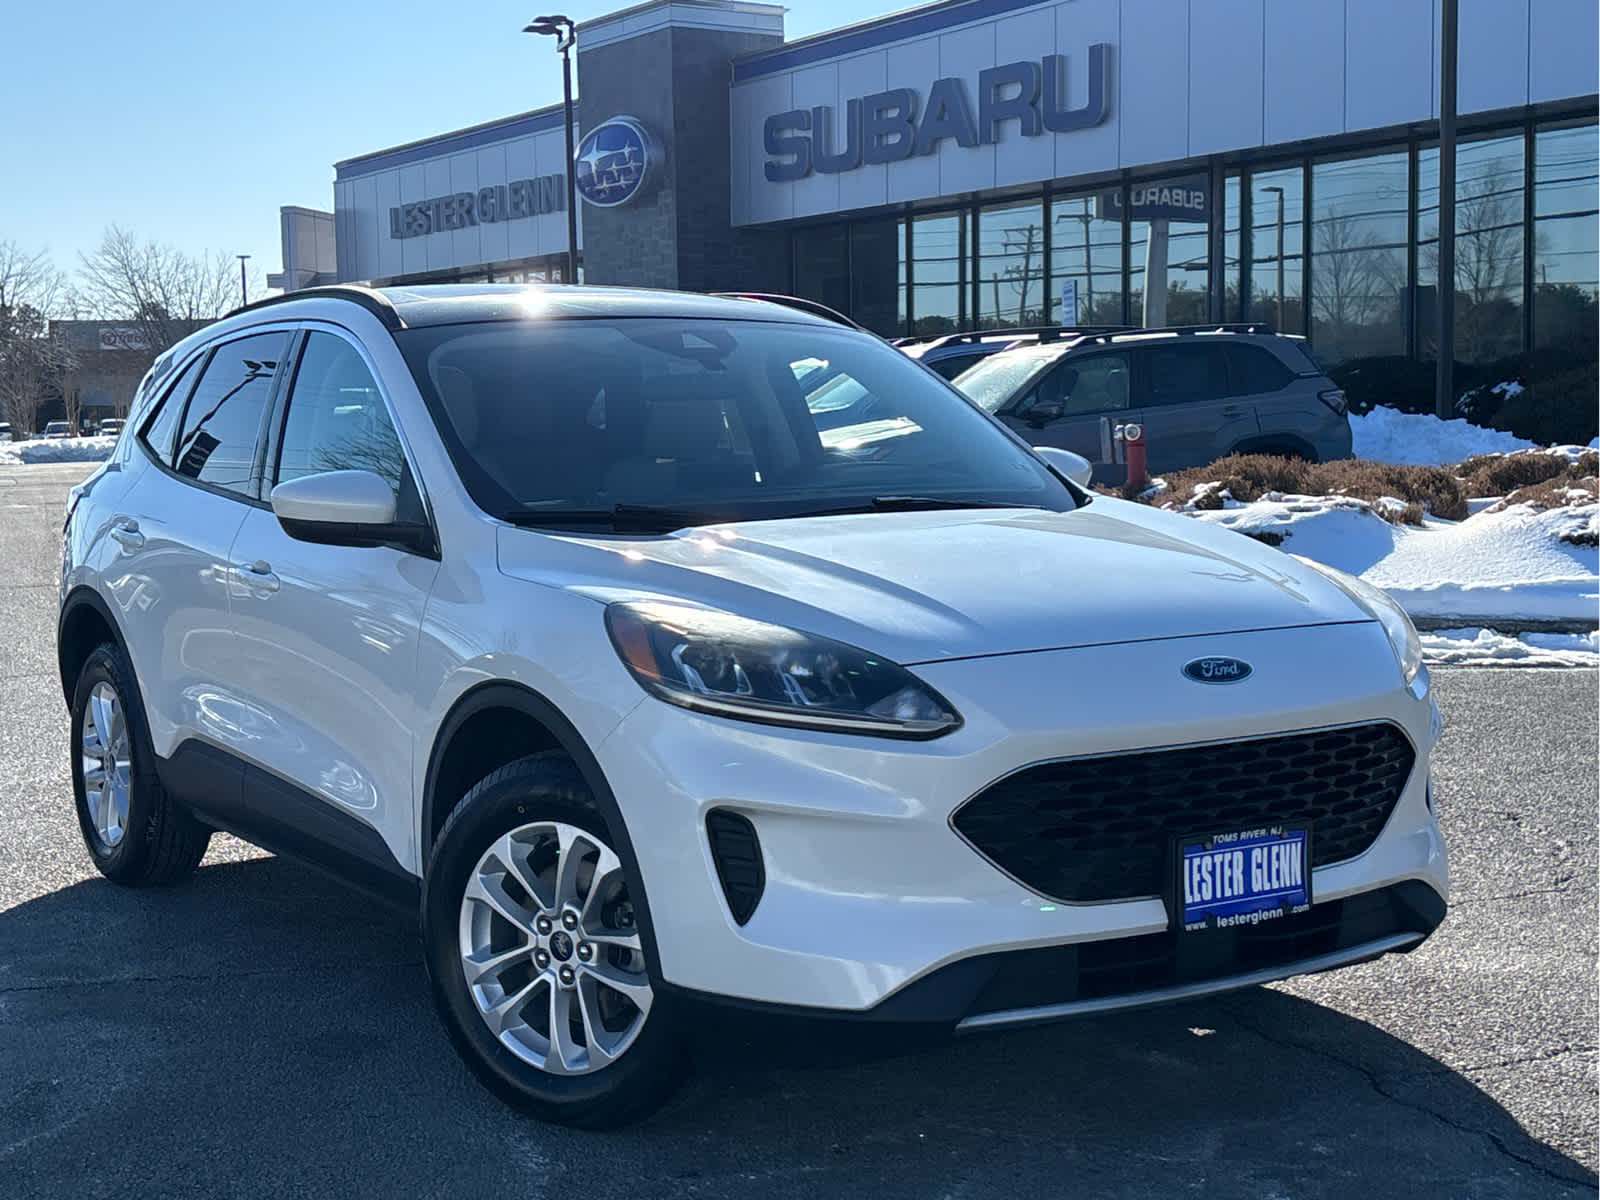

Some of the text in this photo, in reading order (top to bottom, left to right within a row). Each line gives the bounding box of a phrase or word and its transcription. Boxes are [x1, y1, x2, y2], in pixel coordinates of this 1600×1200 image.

[763, 42, 1113, 182] SUBARU
[389, 174, 567, 240] LESTER GLENN
[1201, 660, 1241, 677] Ford
[1212, 832, 1239, 844] TOMS
[1270, 826, 1283, 836] NJ
[1184, 842, 1302, 904] LESTER GLENN
[1185, 921, 1208, 931] www.
[1217, 908, 1283, 928] lesterglenn
